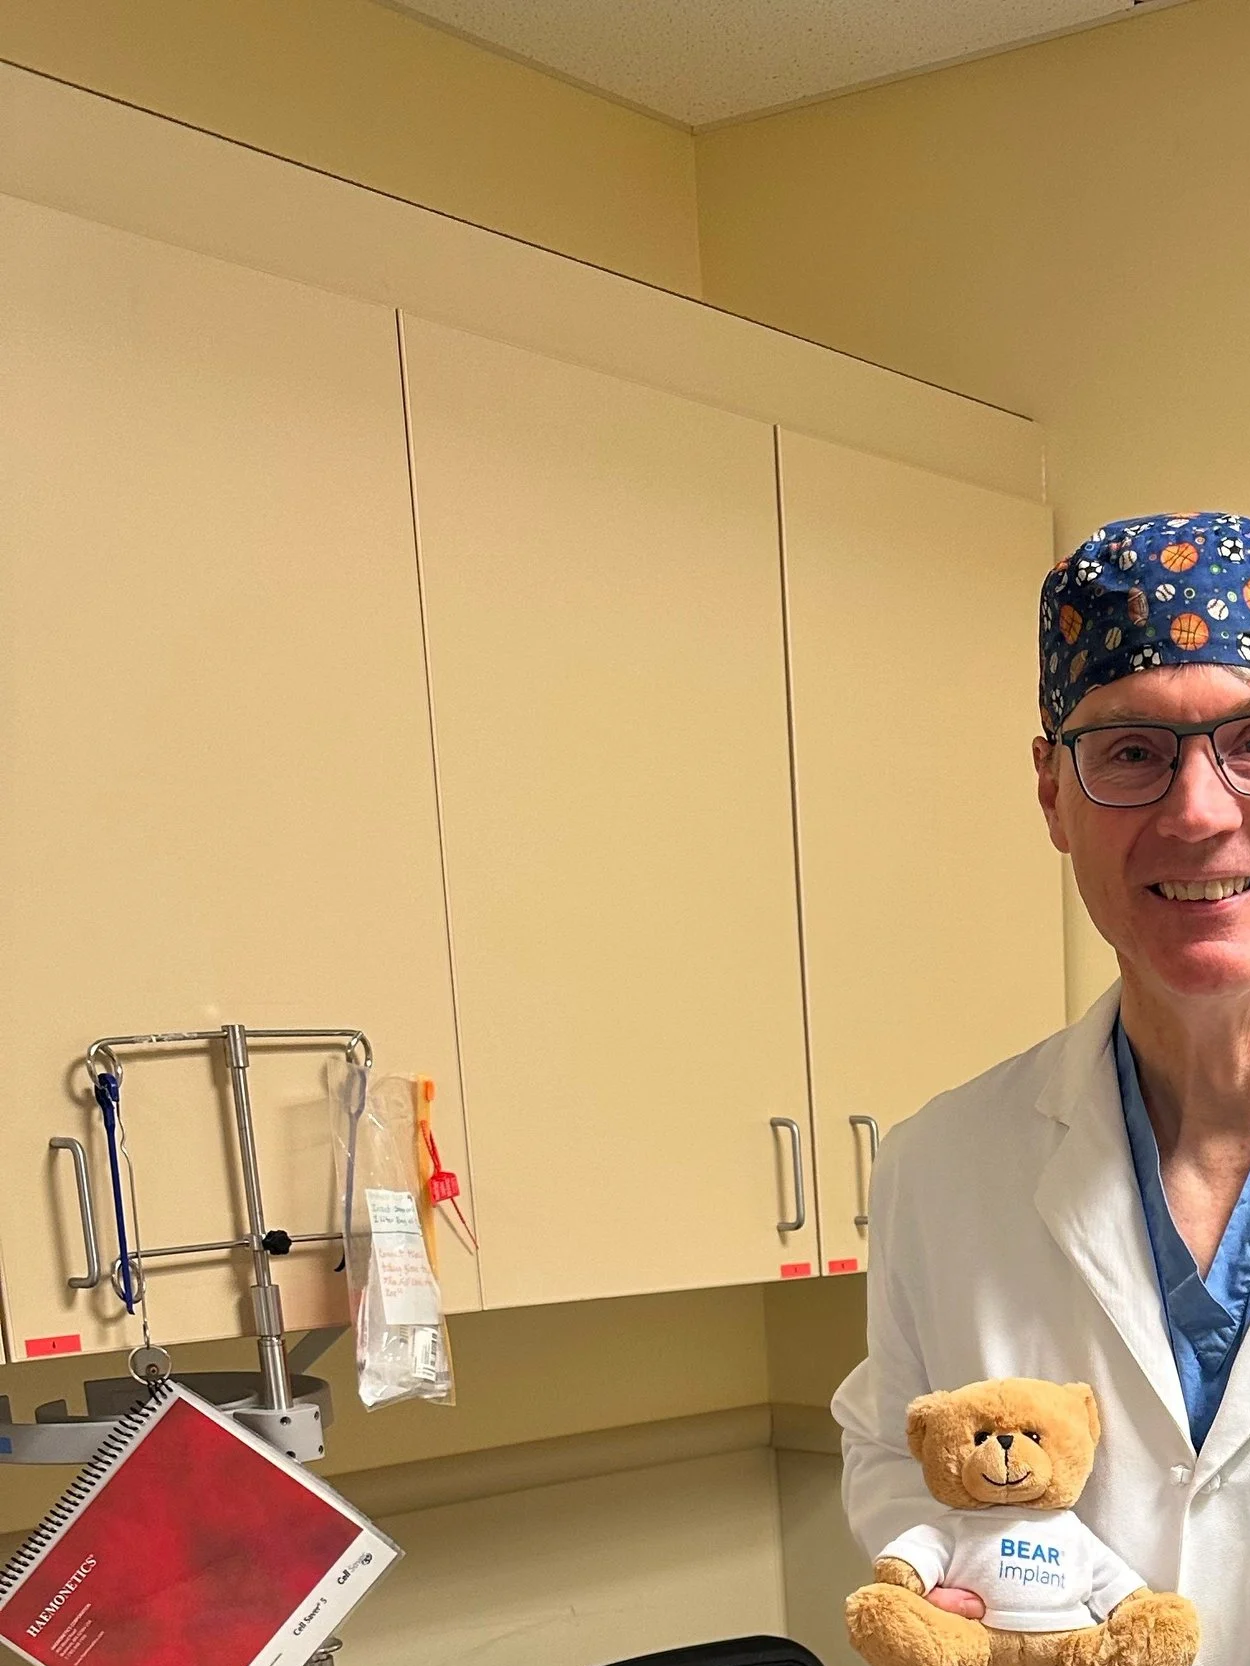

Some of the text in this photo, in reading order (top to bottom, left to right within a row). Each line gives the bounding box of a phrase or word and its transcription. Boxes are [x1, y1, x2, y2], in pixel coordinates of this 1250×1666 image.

[1001, 1538, 1060, 1566] BEAR
[999, 1560, 1066, 1589] Implant
[293, 1621, 307, 1636] Cell
